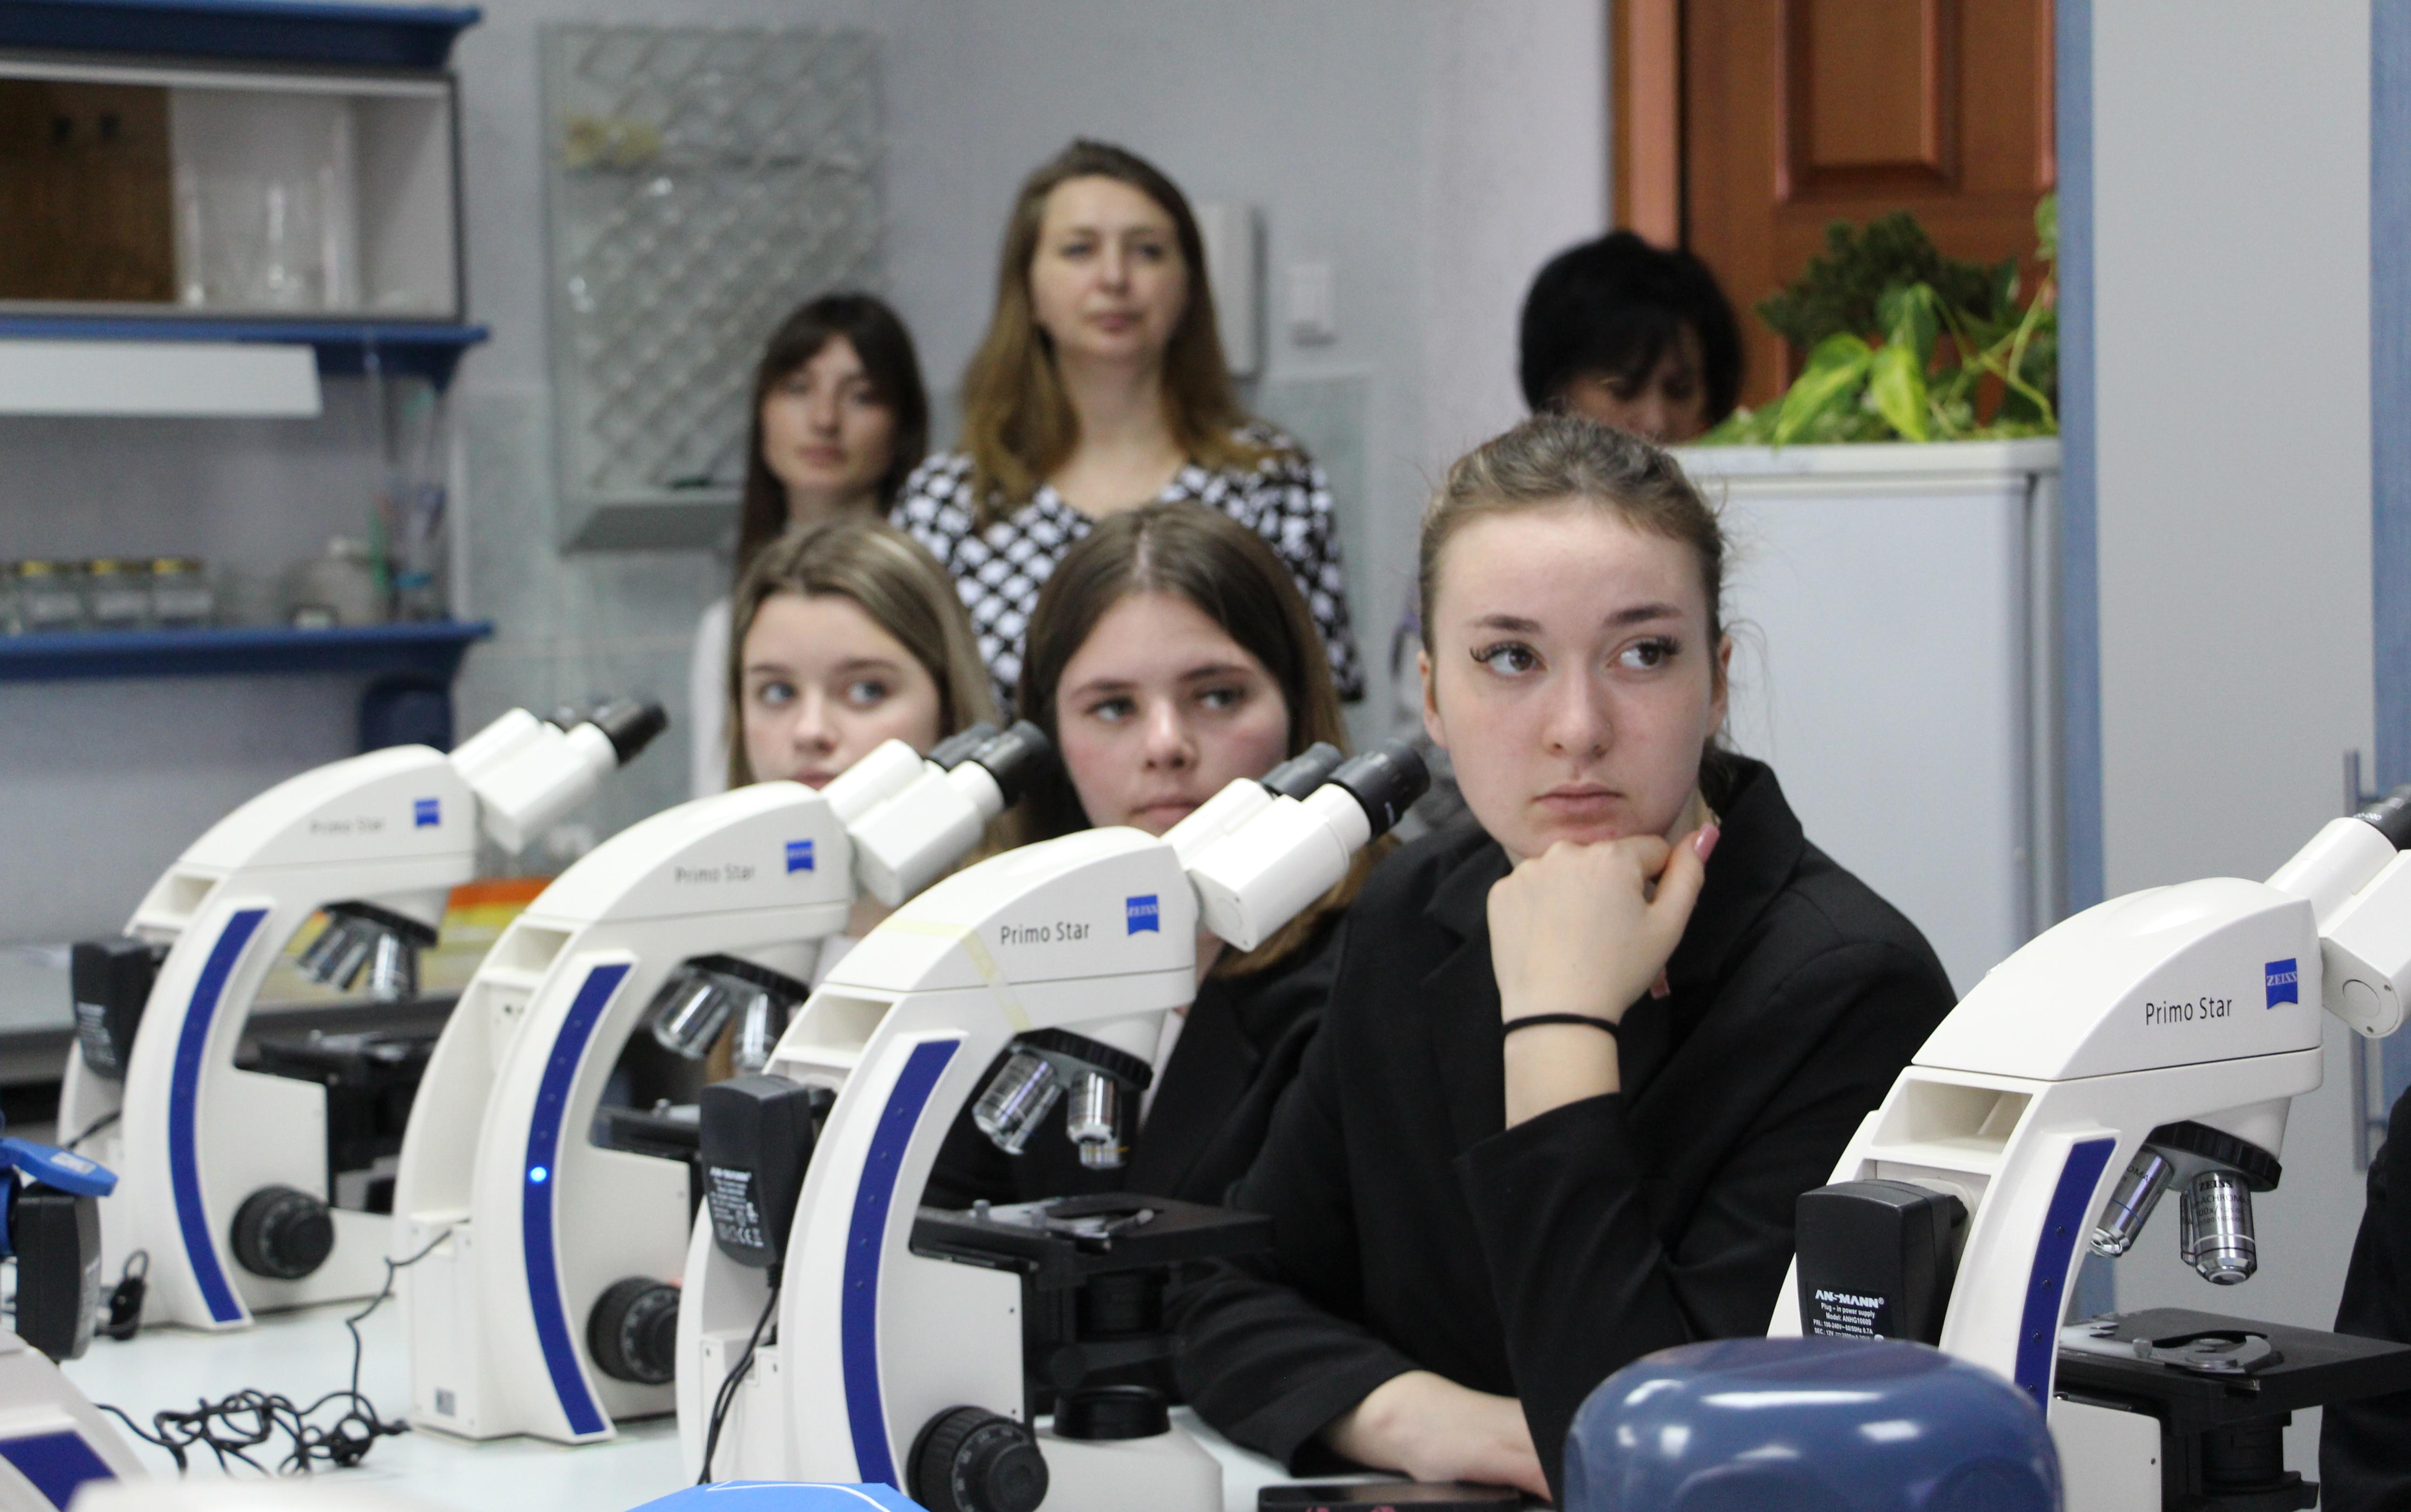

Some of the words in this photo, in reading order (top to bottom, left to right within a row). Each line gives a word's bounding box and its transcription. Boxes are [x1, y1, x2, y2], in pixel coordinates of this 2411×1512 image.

[1001, 924, 1050, 945] Primo
[1056, 922, 1090, 942] Star
[2266, 971, 2297, 987] ZEISS
[2145, 1001, 2193, 1025] Primo
[2199, 997, 2232, 1019] Star
[2199, 1180, 2233, 1191] ZEISS
[1821, 1302, 1832, 1312] Plug
[1858, 1310, 1875, 1319] supply
[1826, 1312, 1842, 1320] Model:
